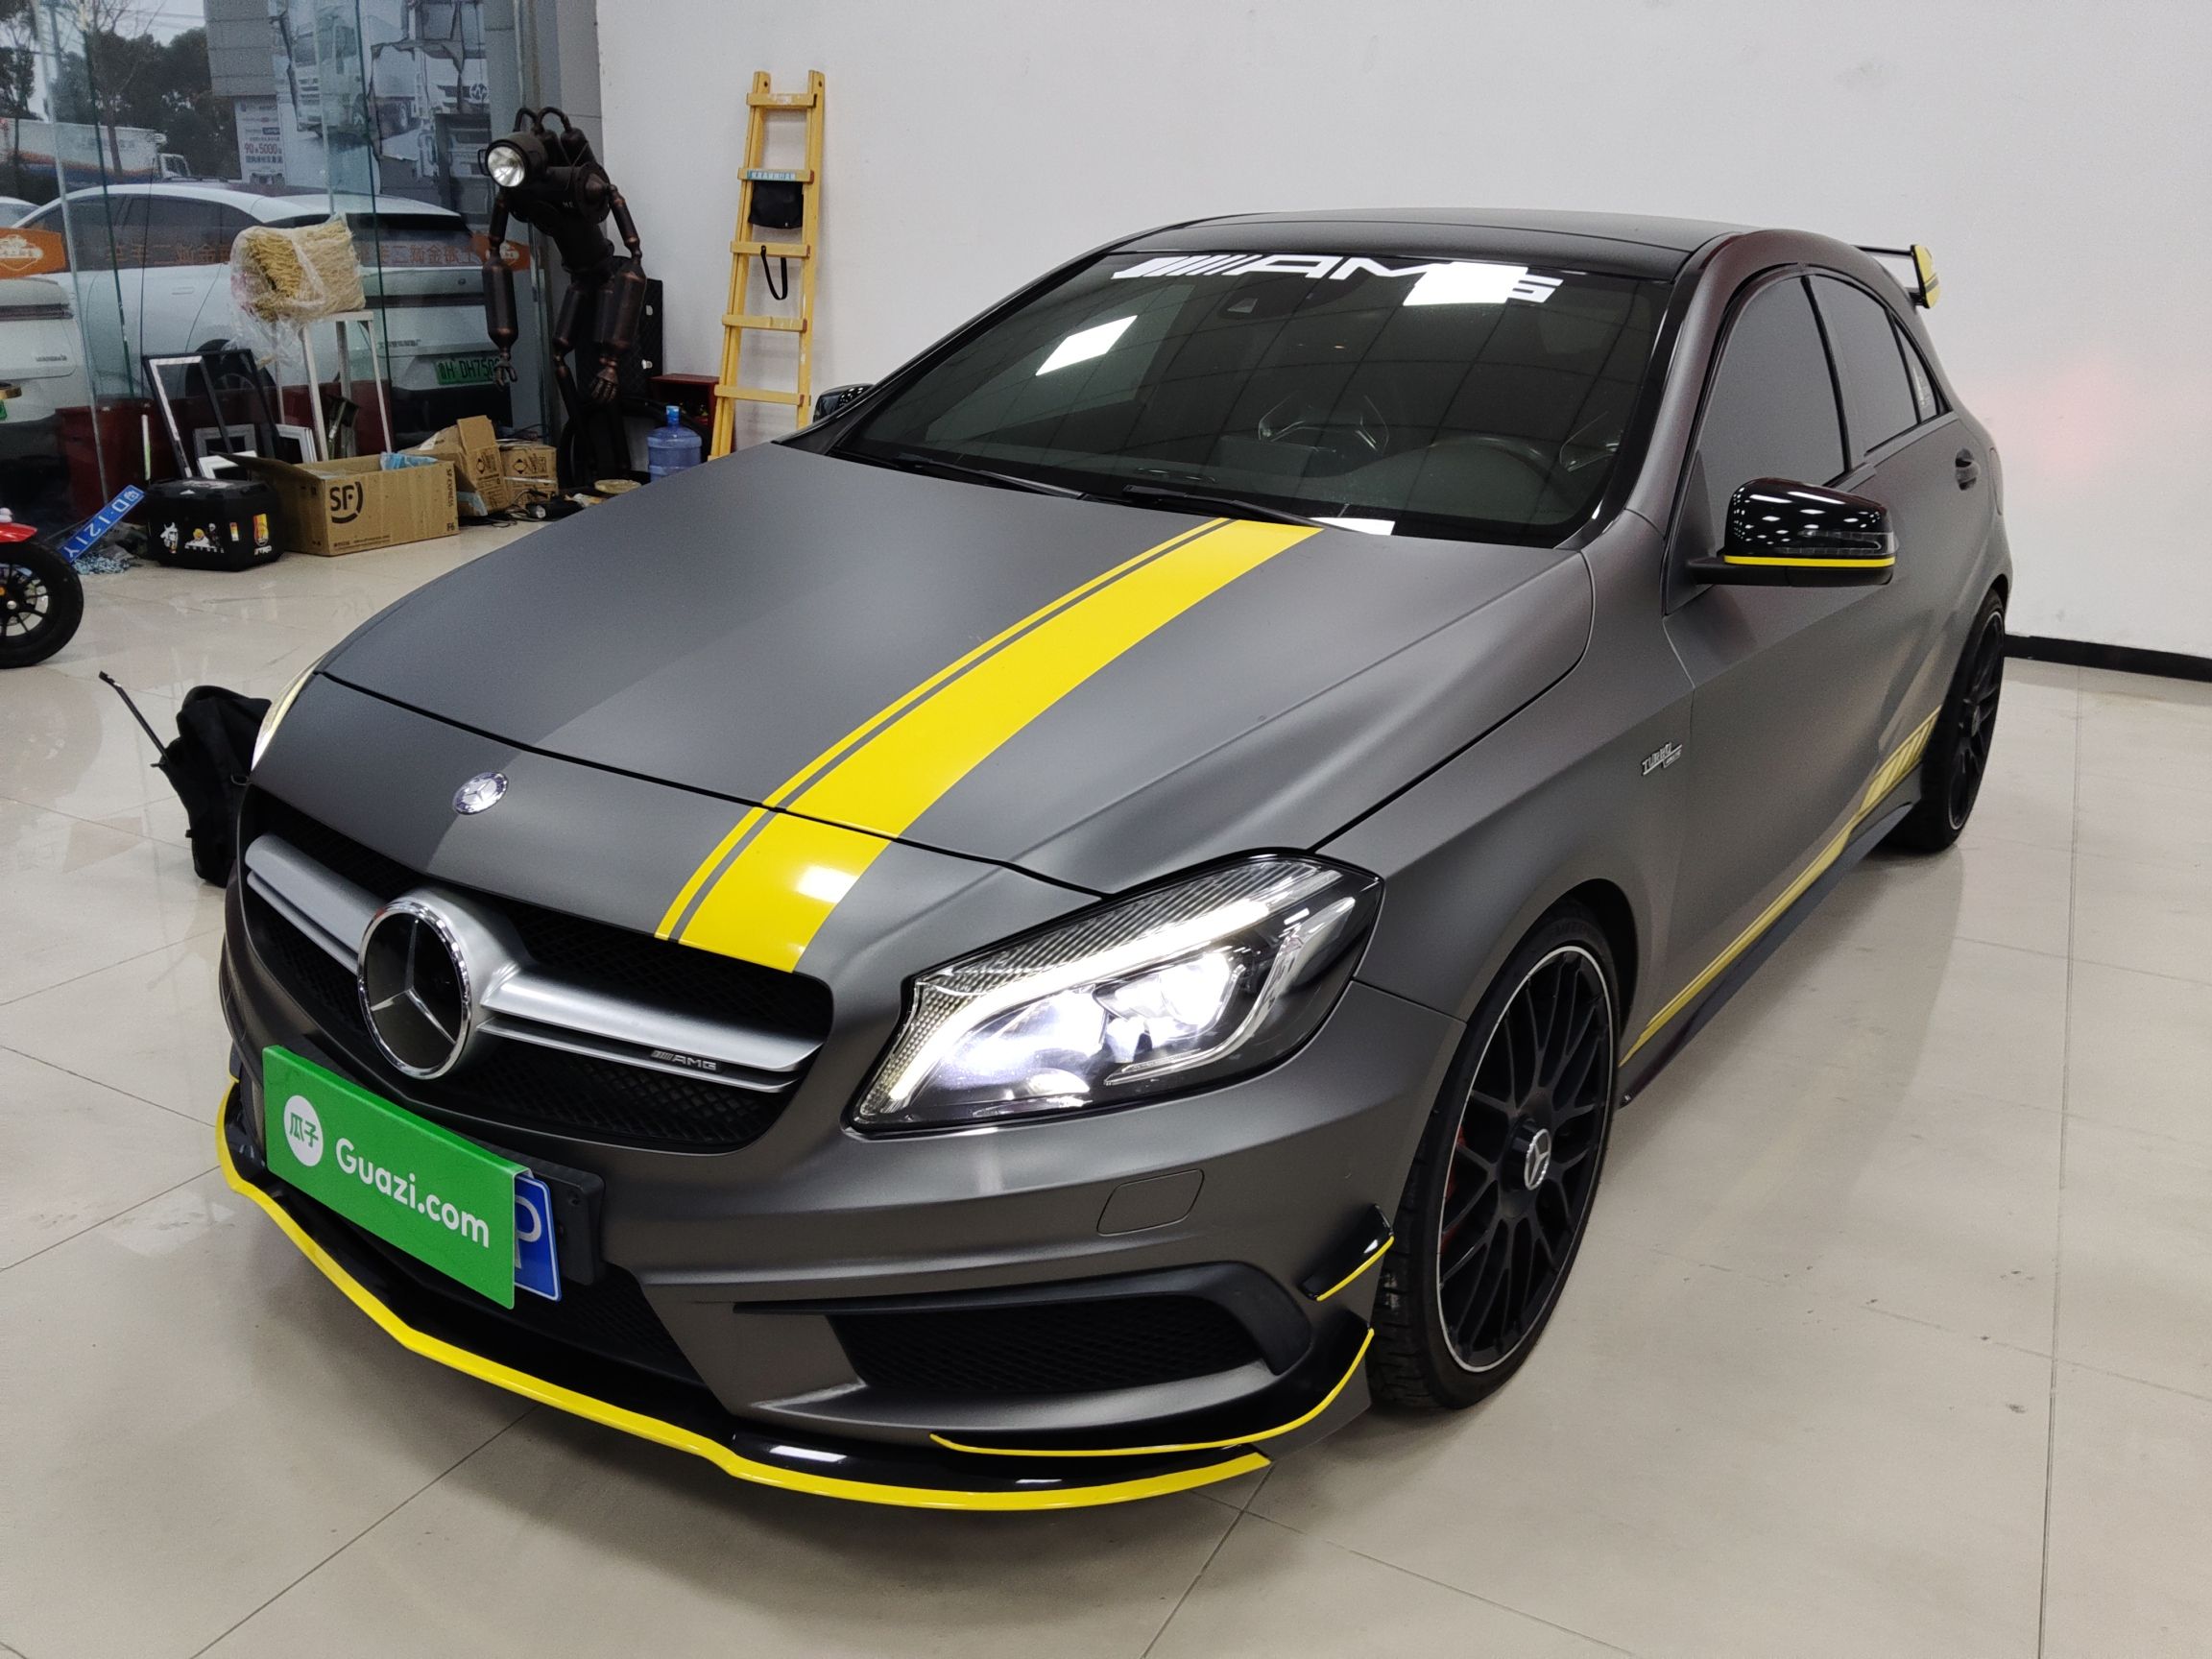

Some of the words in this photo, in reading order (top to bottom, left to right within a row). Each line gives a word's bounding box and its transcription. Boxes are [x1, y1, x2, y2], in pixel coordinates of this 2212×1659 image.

[330, 485, 354, 512] SF
[672, 1054, 717, 1071] AMG
[289, 1112, 319, 1147] 瓜子
[336, 1138, 489, 1248] Guazi.com
